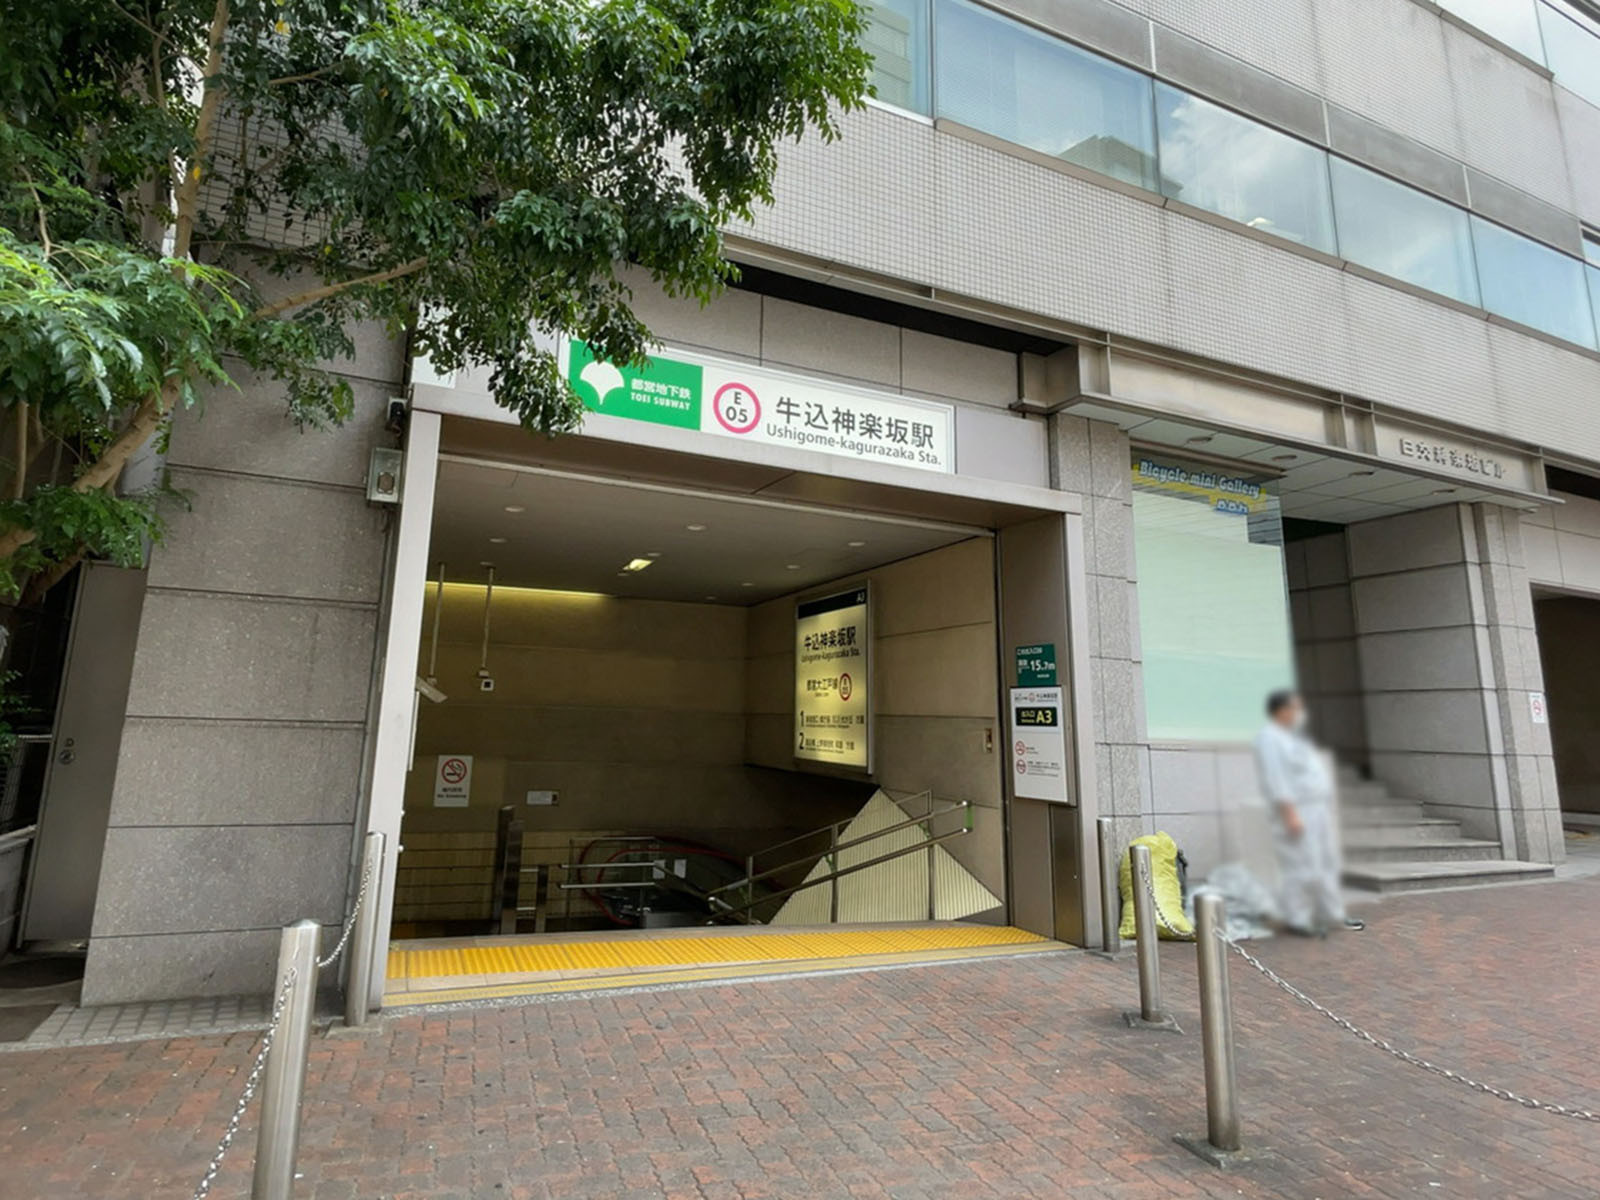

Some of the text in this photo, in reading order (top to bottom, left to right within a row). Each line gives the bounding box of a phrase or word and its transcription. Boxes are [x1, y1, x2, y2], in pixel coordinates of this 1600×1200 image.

[631, 378, 691, 400] 都営地下鉄
[631, 392, 690, 411] TOEI SUBWAY
[734, 391, 742, 406] E
[725, 406, 748, 424] 05
[776, 397, 934, 449] 牛込神楽坂駅
[766, 423, 942, 466] Ushigome-kagurazaka Sta.
[1140, 461, 1260, 499] Bicycle mini Gallery
[800, 710, 805, 727] 1
[1036, 710, 1053, 724] A3
[799, 732, 805, 750] 2
